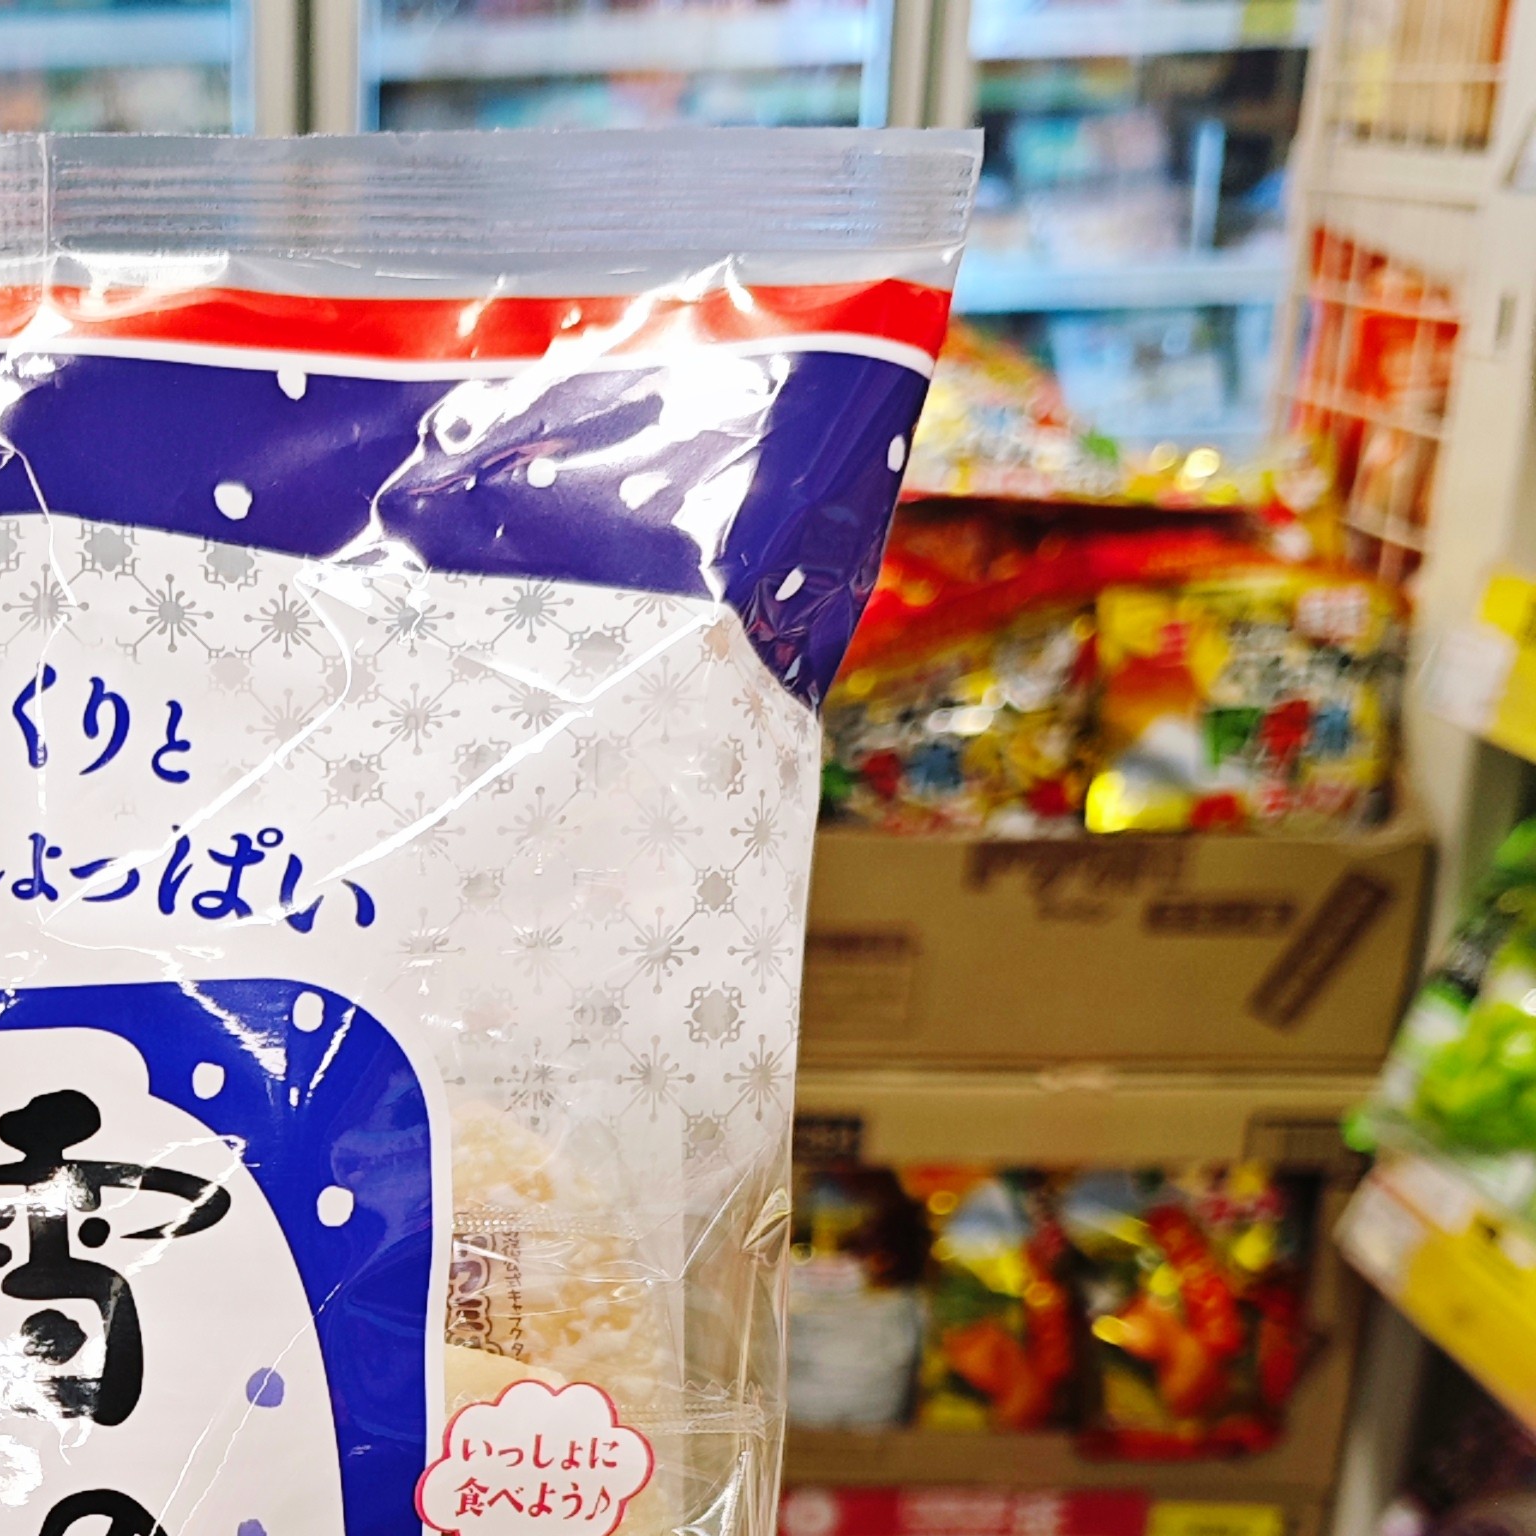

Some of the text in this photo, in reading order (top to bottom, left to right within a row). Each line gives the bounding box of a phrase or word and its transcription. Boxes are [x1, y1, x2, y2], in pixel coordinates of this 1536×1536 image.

[462, 1433, 620, 1471] いっしょに
